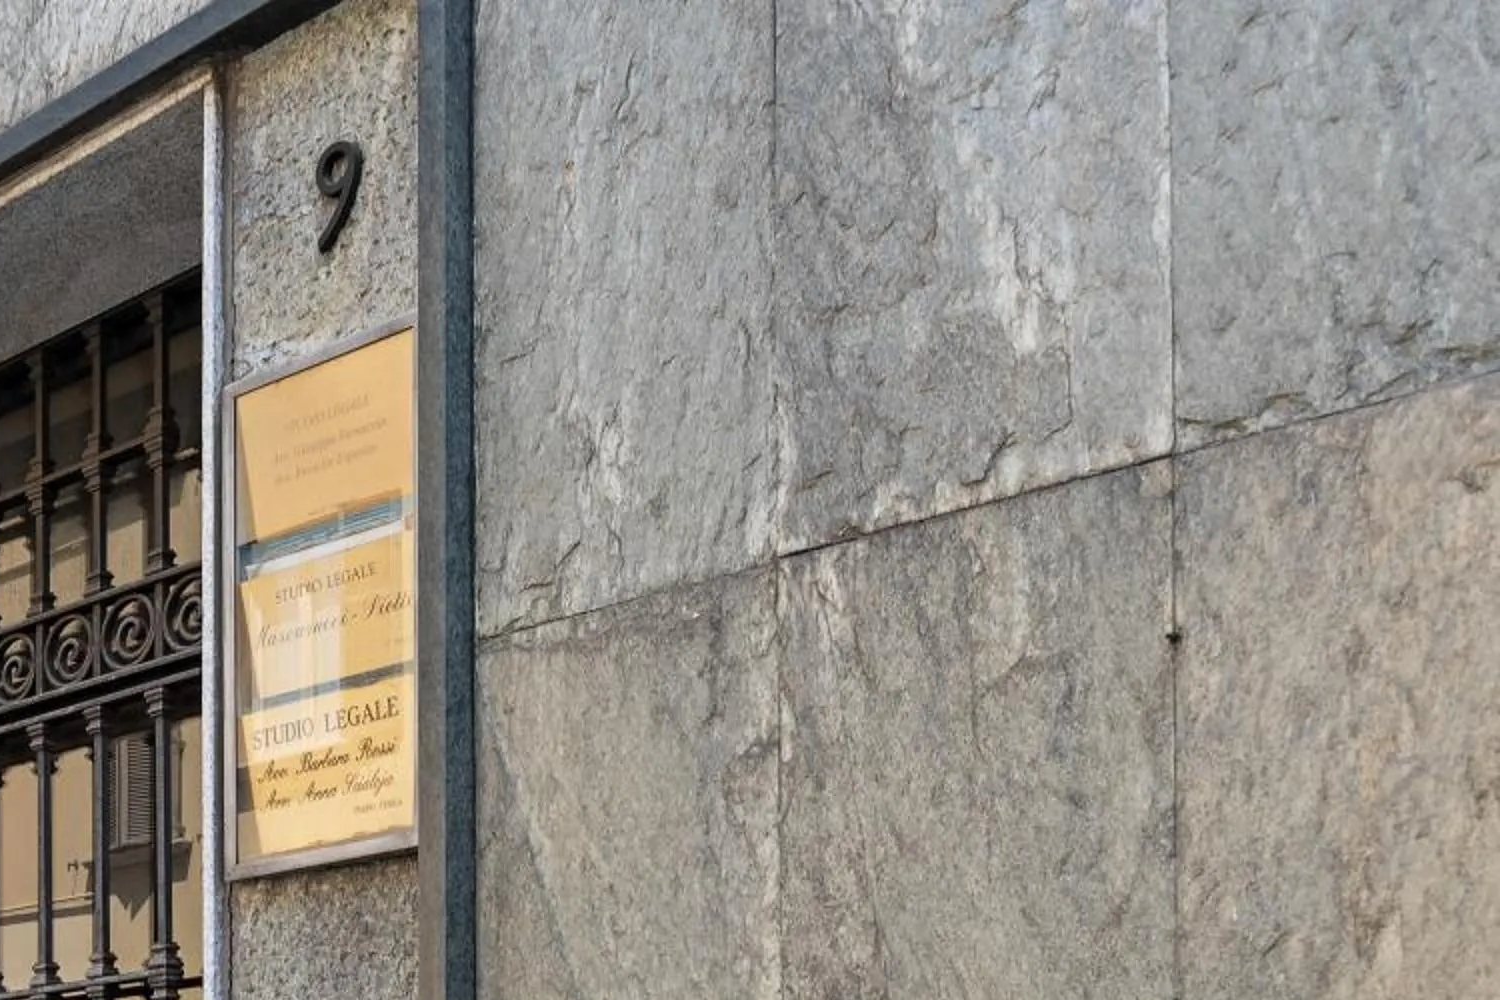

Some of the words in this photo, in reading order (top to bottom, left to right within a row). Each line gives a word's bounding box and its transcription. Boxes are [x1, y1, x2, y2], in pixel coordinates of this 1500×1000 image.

[315, 140, 364, 253] 9
[275, 577, 322, 605] STUDIO
[326, 561, 377, 589] LEGALE
[252, 717, 314, 750] STUDIO
[324, 695, 399, 732] LEGALE
